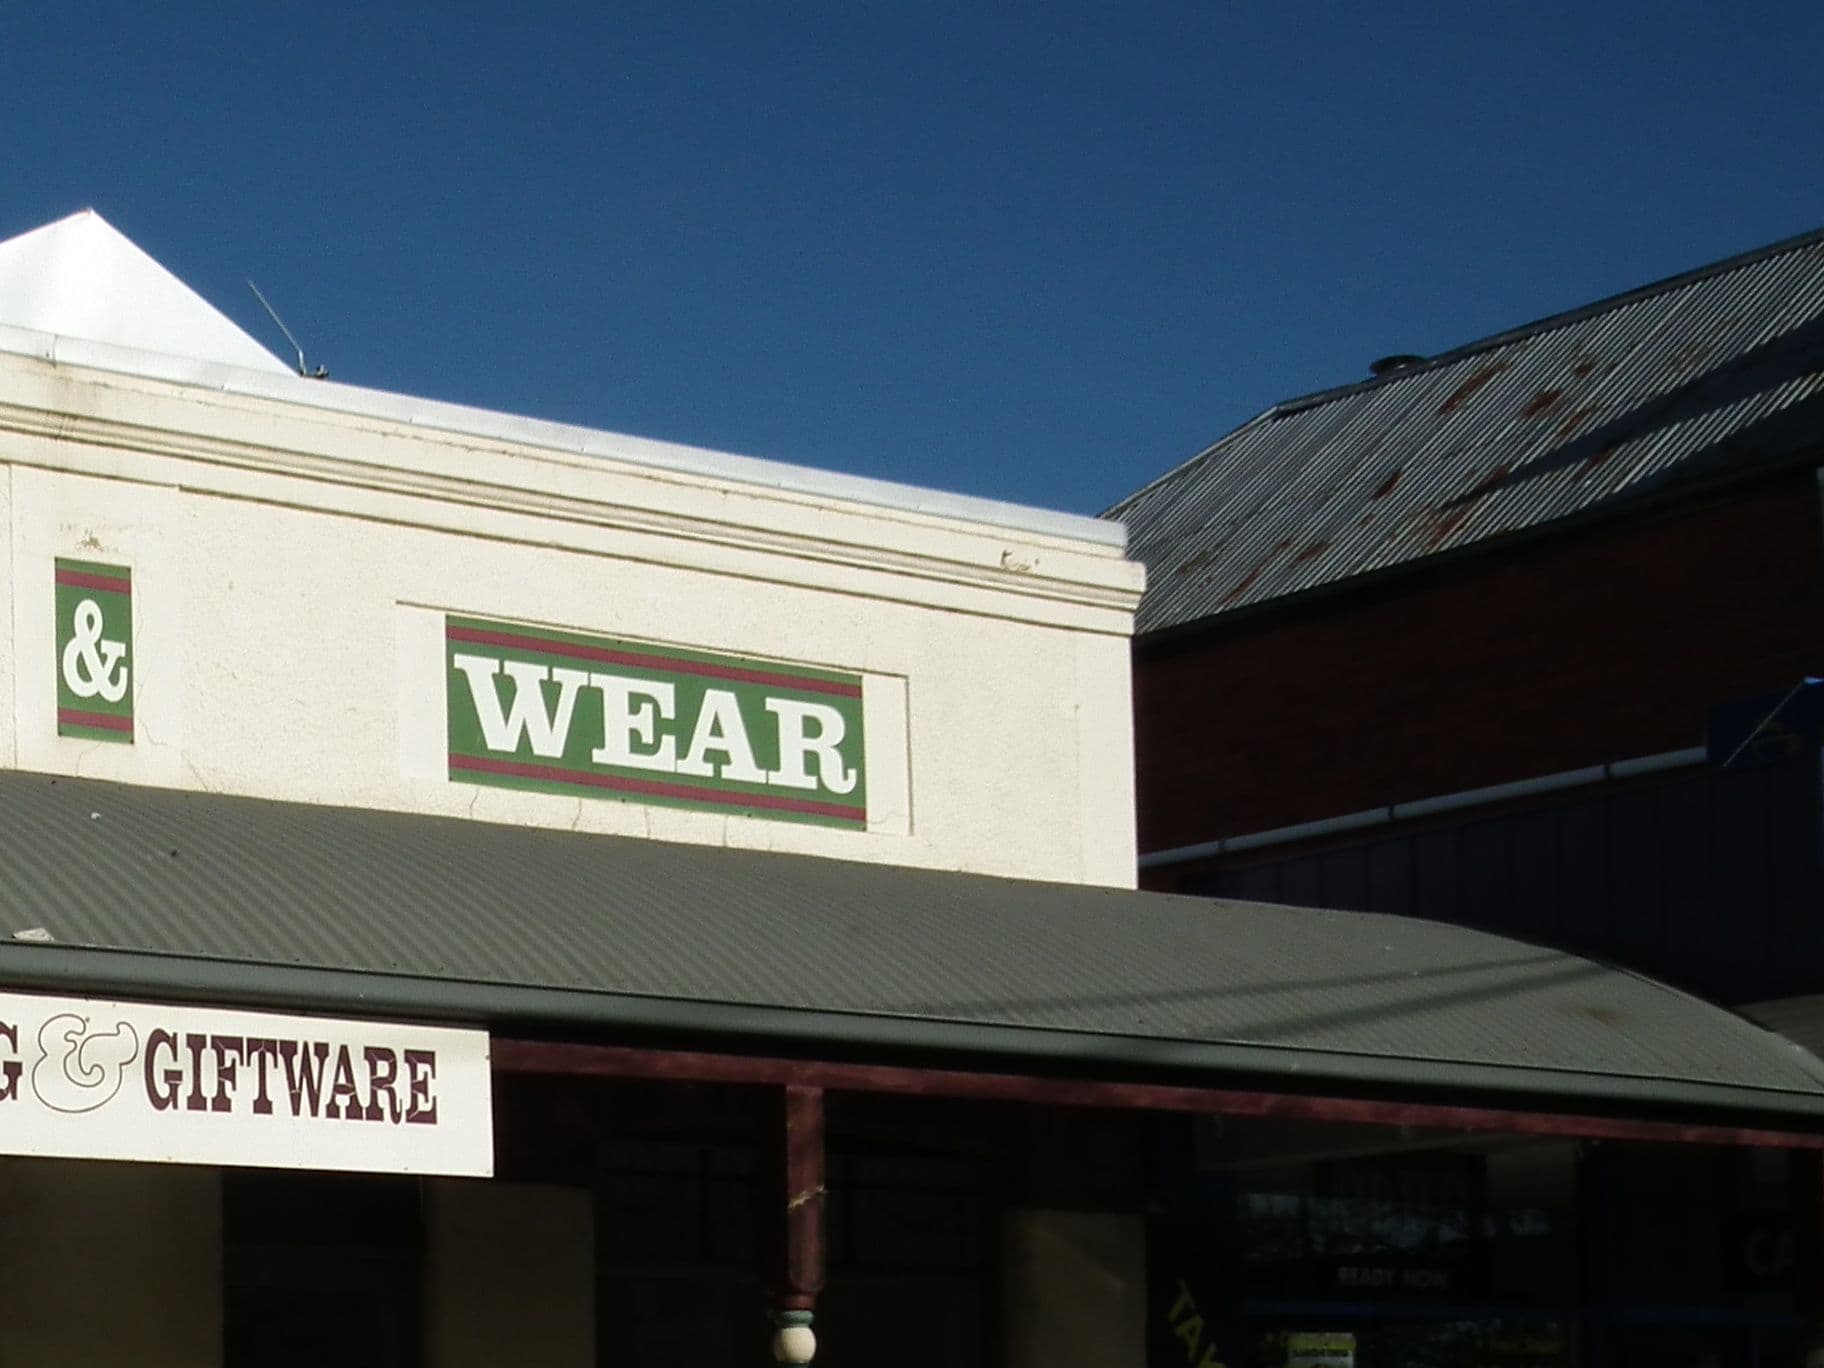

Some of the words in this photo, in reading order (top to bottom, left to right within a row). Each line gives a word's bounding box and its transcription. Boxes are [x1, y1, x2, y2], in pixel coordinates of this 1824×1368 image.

[62, 598, 128, 704] &
[453, 652, 858, 795] WEAR
[31, 1012, 139, 1114] &
[144, 1028, 439, 1126] GIFTWARE
